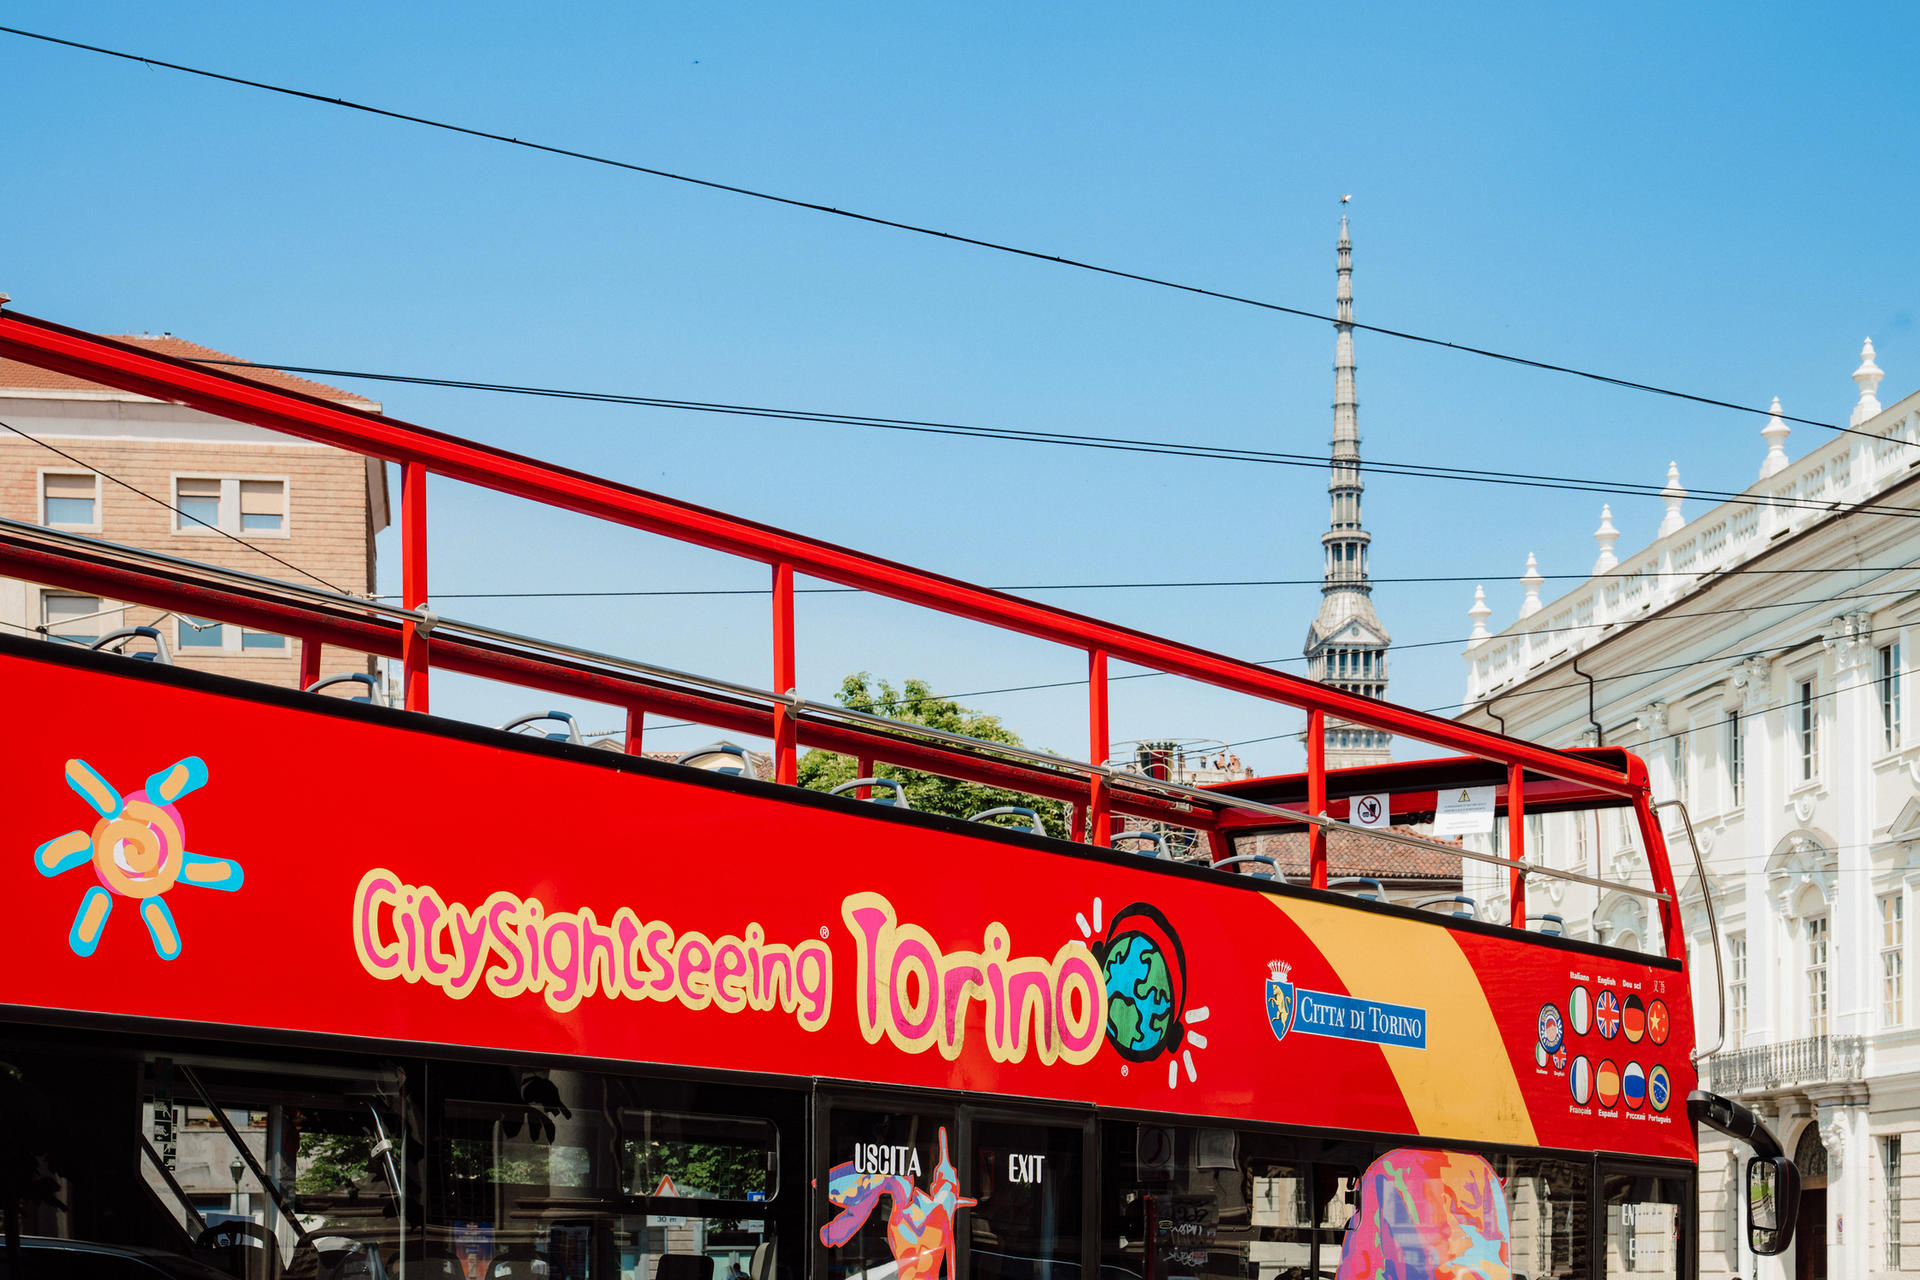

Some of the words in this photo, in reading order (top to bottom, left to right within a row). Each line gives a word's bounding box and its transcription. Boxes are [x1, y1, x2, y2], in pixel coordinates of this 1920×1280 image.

[841, 892, 1108, 1066] Torino
[1597, 975, 1616, 986] English
[1369, 1006, 1422, 1038] TORINO
[855, 1142, 921, 1177] USCITA
[1009, 1153, 1046, 1183] EXIT
